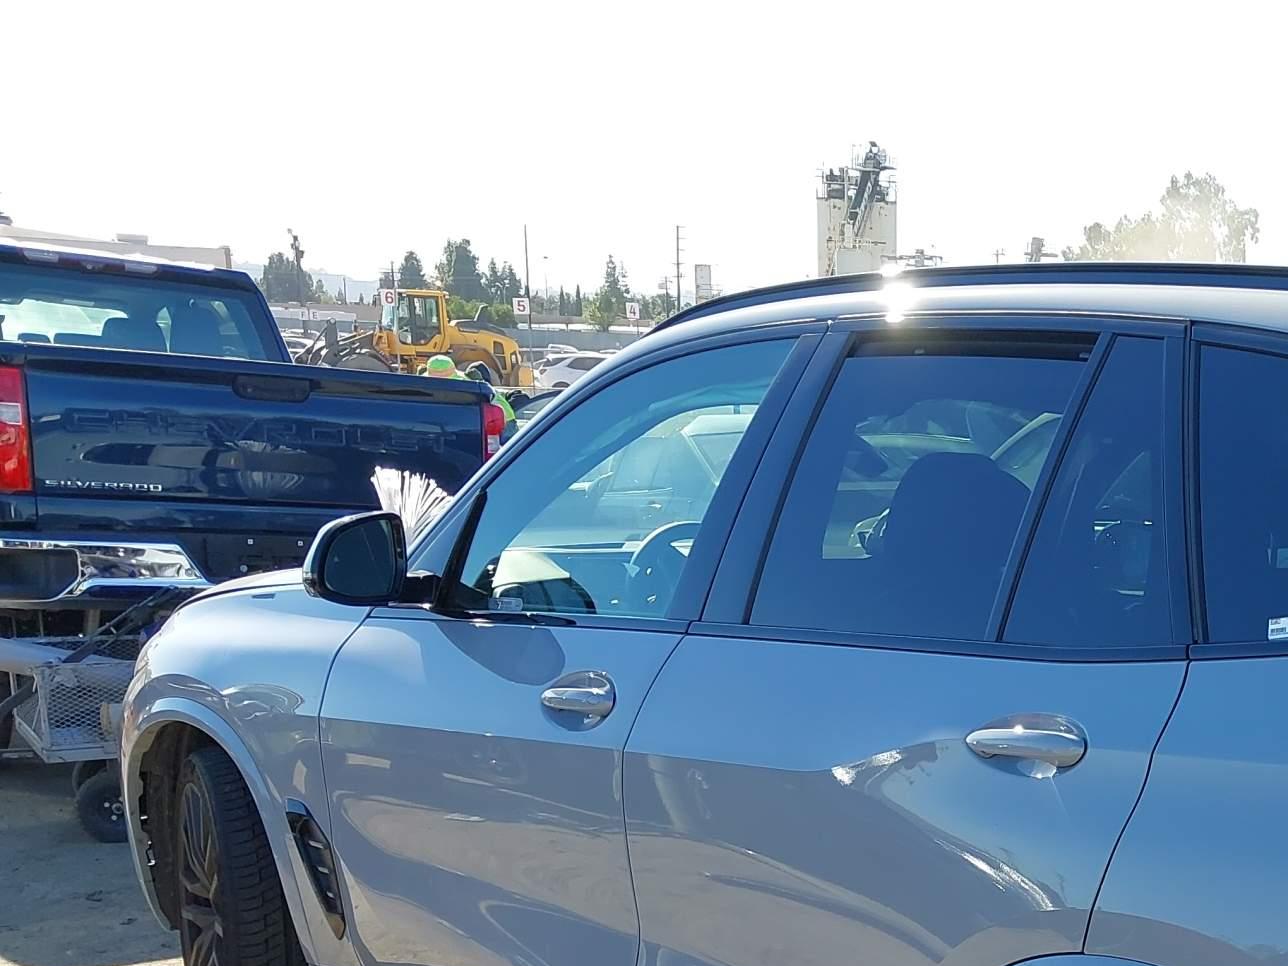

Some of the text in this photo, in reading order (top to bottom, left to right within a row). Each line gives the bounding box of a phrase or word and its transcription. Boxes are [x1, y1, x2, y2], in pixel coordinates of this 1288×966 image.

[383, 288, 395, 304] 6
[516, 301, 527, 313] 5
[628, 303, 637, 317] 4
[65, 408, 458, 452] CHEVROLET
[44, 479, 164, 493] SILVERADO
